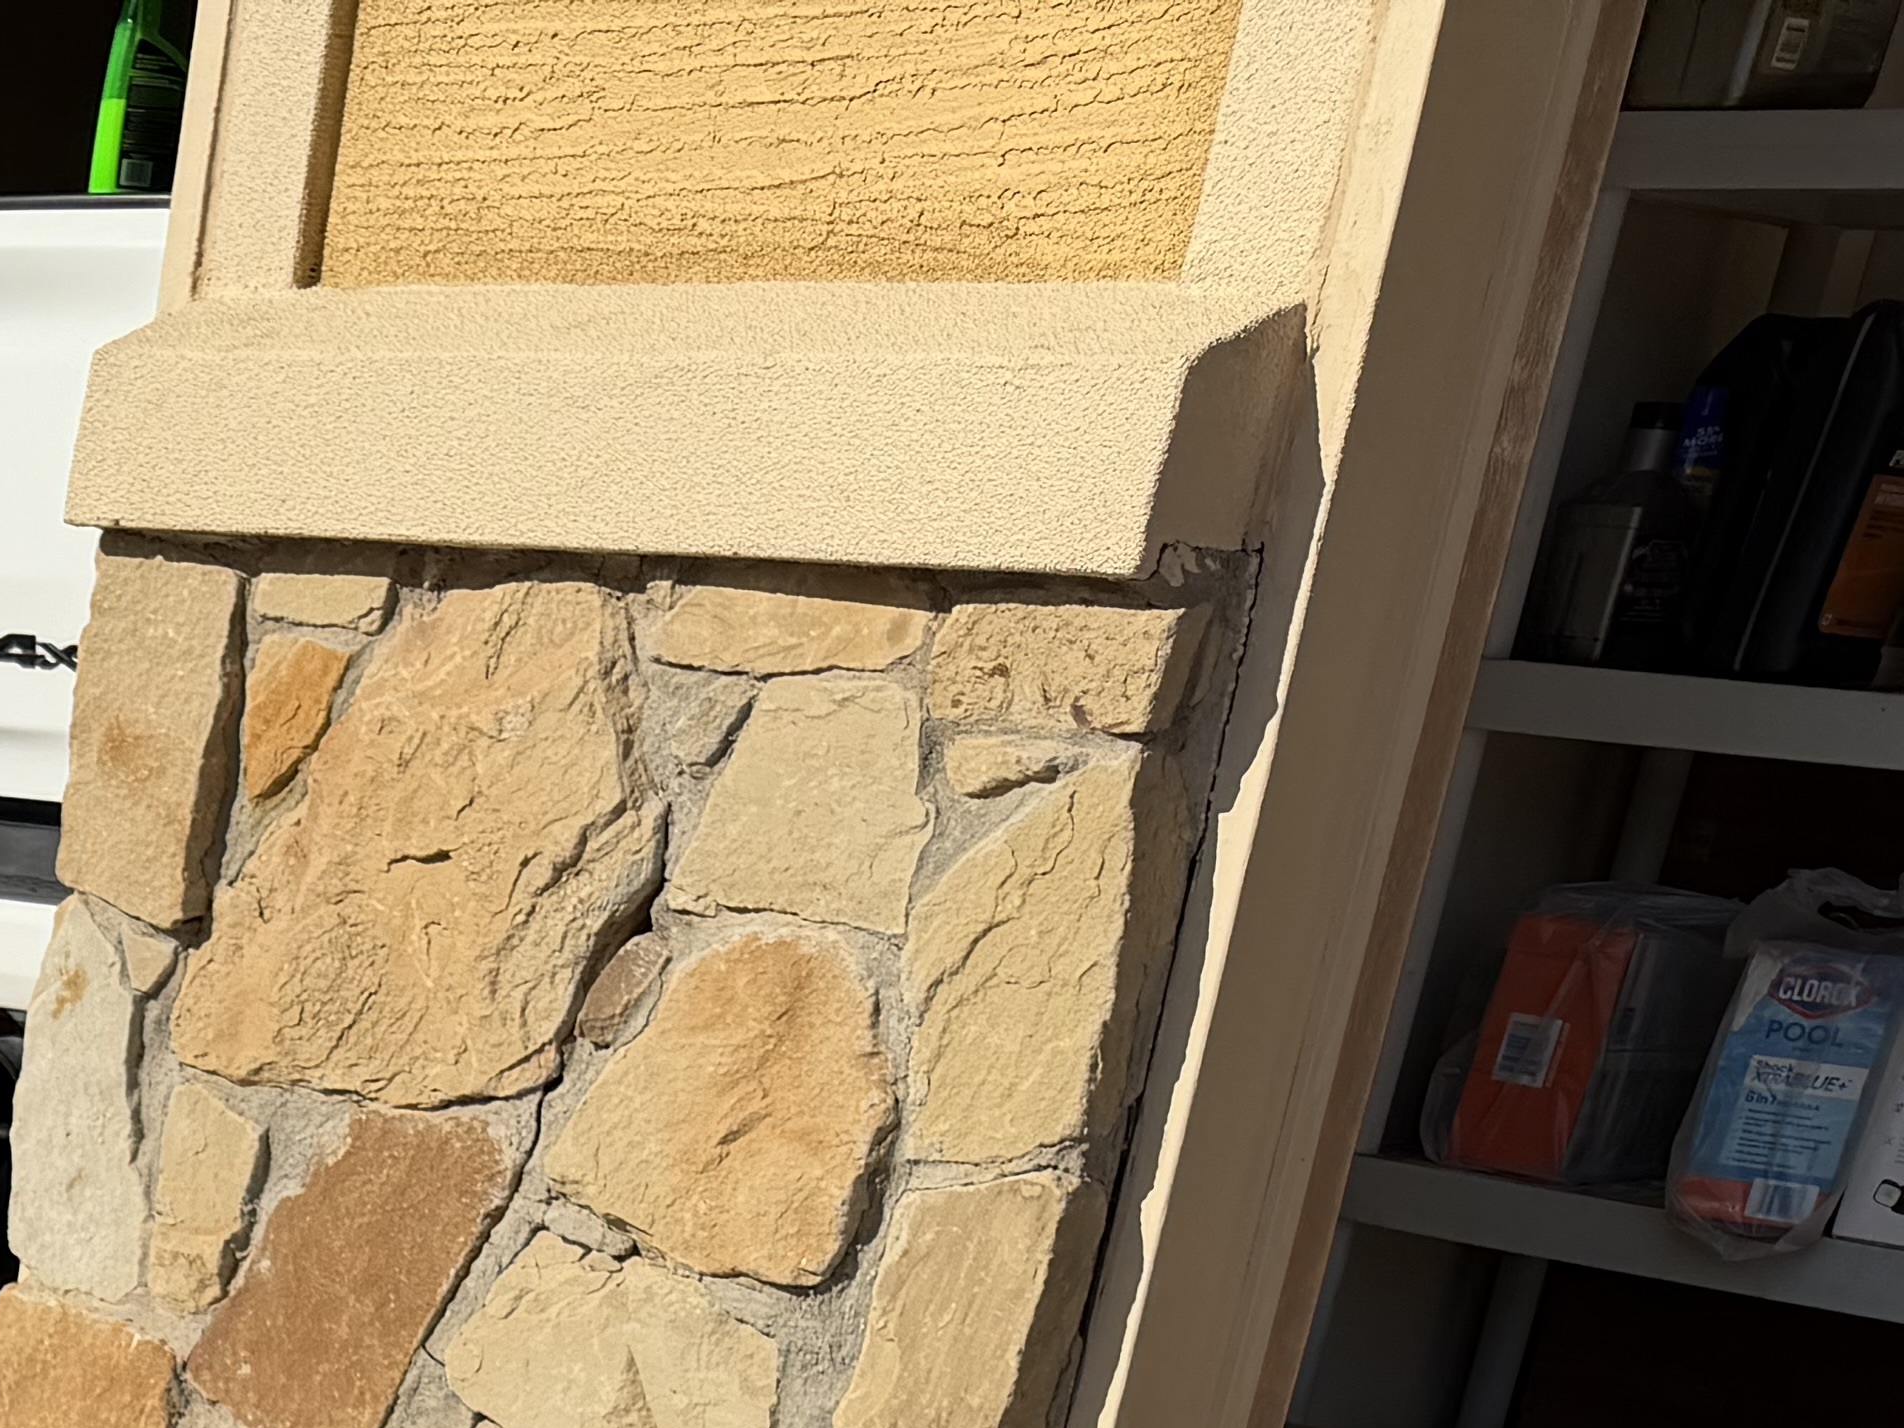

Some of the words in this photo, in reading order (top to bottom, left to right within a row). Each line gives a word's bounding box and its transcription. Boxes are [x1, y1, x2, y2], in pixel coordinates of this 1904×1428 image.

[1778, 977, 1861, 1007] CLOROX
[1765, 1020, 1844, 1048] POOL
[1756, 1060, 1794, 1073] Shock
